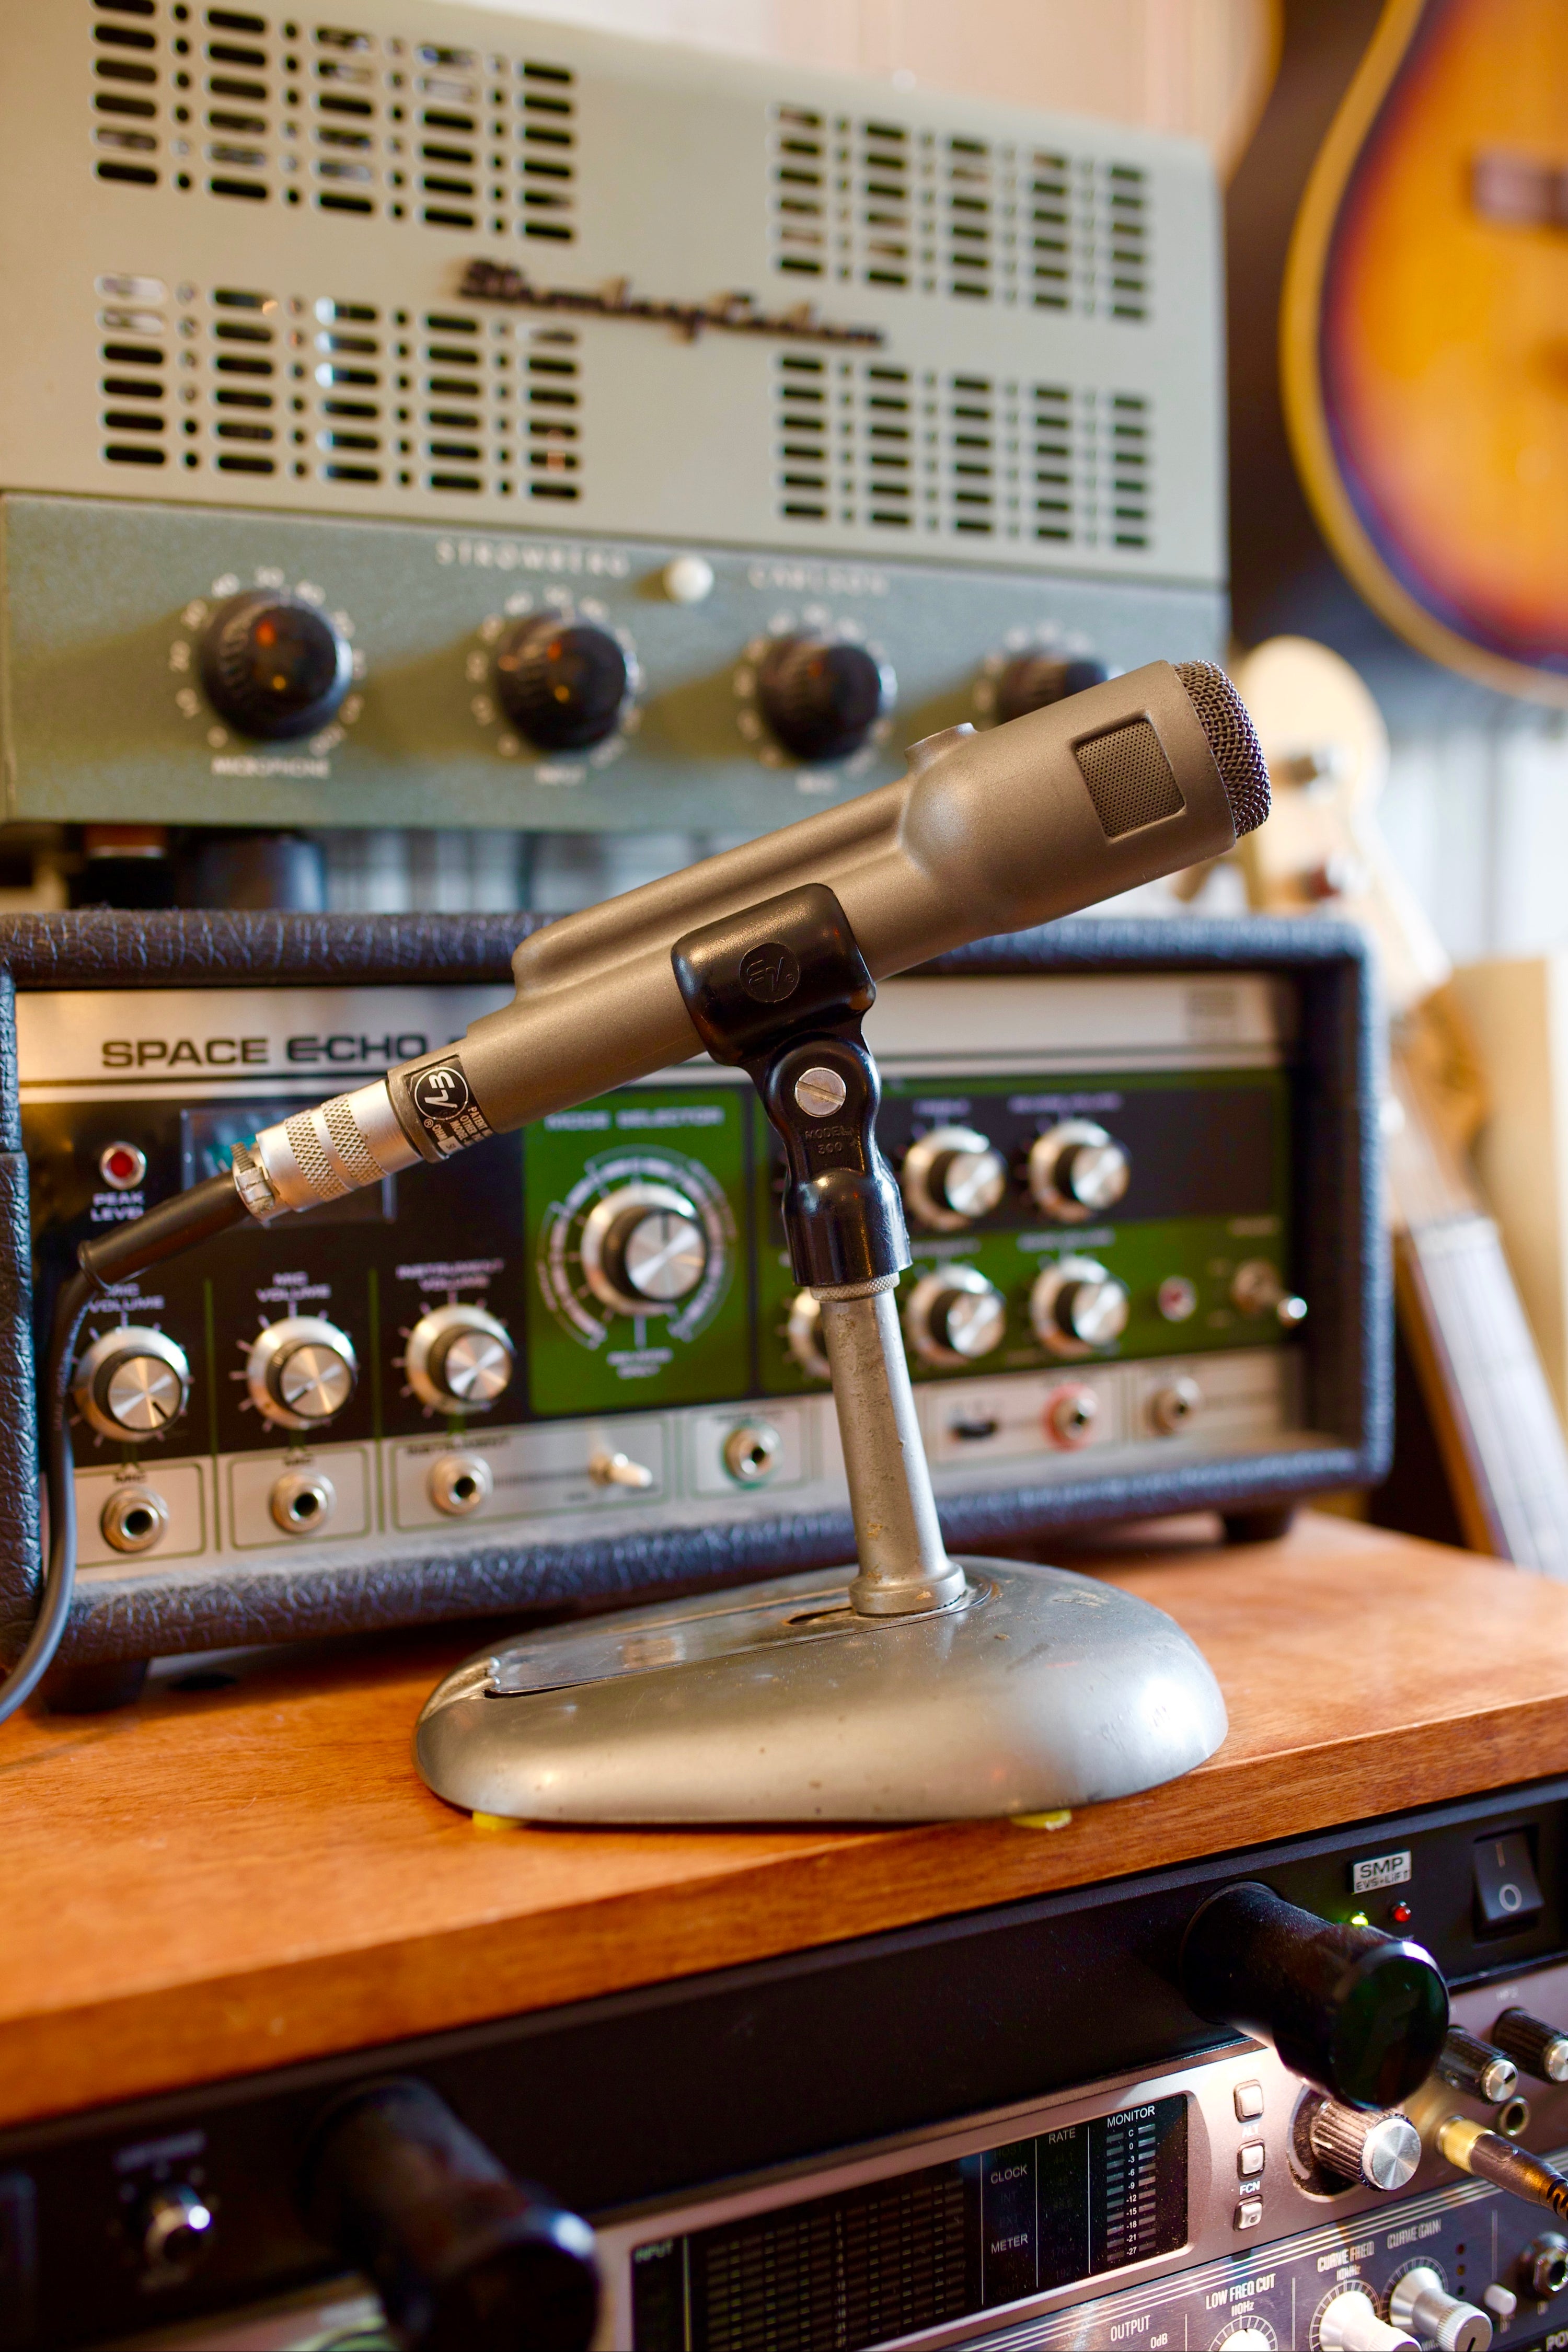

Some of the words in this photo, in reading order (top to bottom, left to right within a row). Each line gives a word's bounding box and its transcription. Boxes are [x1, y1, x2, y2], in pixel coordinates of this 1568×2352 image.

[102, 1037, 270, 1068] SPACE
[285, 1034, 428, 1062] ECHO
[460, 1115, 478, 1135] OTHER
[468, 1106, 488, 1131] PATENT
[93, 1191, 144, 1206] PEAK
[90, 1206, 144, 1221] LEVEL
[256, 1284, 331, 1302] VOLUME
[88, 1295, 165, 1313] VOLUME
[1361, 1857, 1403, 1878] SMP
[1107, 2105, 1156, 2128] MONITOR
[1048, 2127, 1076, 2145] RATE
[1242, 2123, 1260, 2138] ALT
[990, 2163, 1028, 2184] CLOCK
[1239, 2181, 1260, 2195] FCN
[1126, 2194, 1137, 2203] -12
[1126, 2207, 1137, 2216] -15
[1126, 2220, 1137, 2229] -18
[1387, 2225, 1417, 2249] CURVE
[1418, 2218, 1442, 2239] GAIN
[991, 2233, 1029, 2254] METER
[1126, 2233, 1136, 2242] -21
[1126, 2246, 1137, 2255] -27
[1317, 2249, 1349, 2273] CURVE
[1206, 2289, 1228, 2310] LOW
[1229, 2280, 1254, 2302] FREQ
[1256, 2273, 1276, 2293] CUT
[1231, 2300, 1254, 2316] 110Hz
[1110, 2314, 1150, 2342] OUTPUT
[1546, 2330, 1568, 2352] PO
